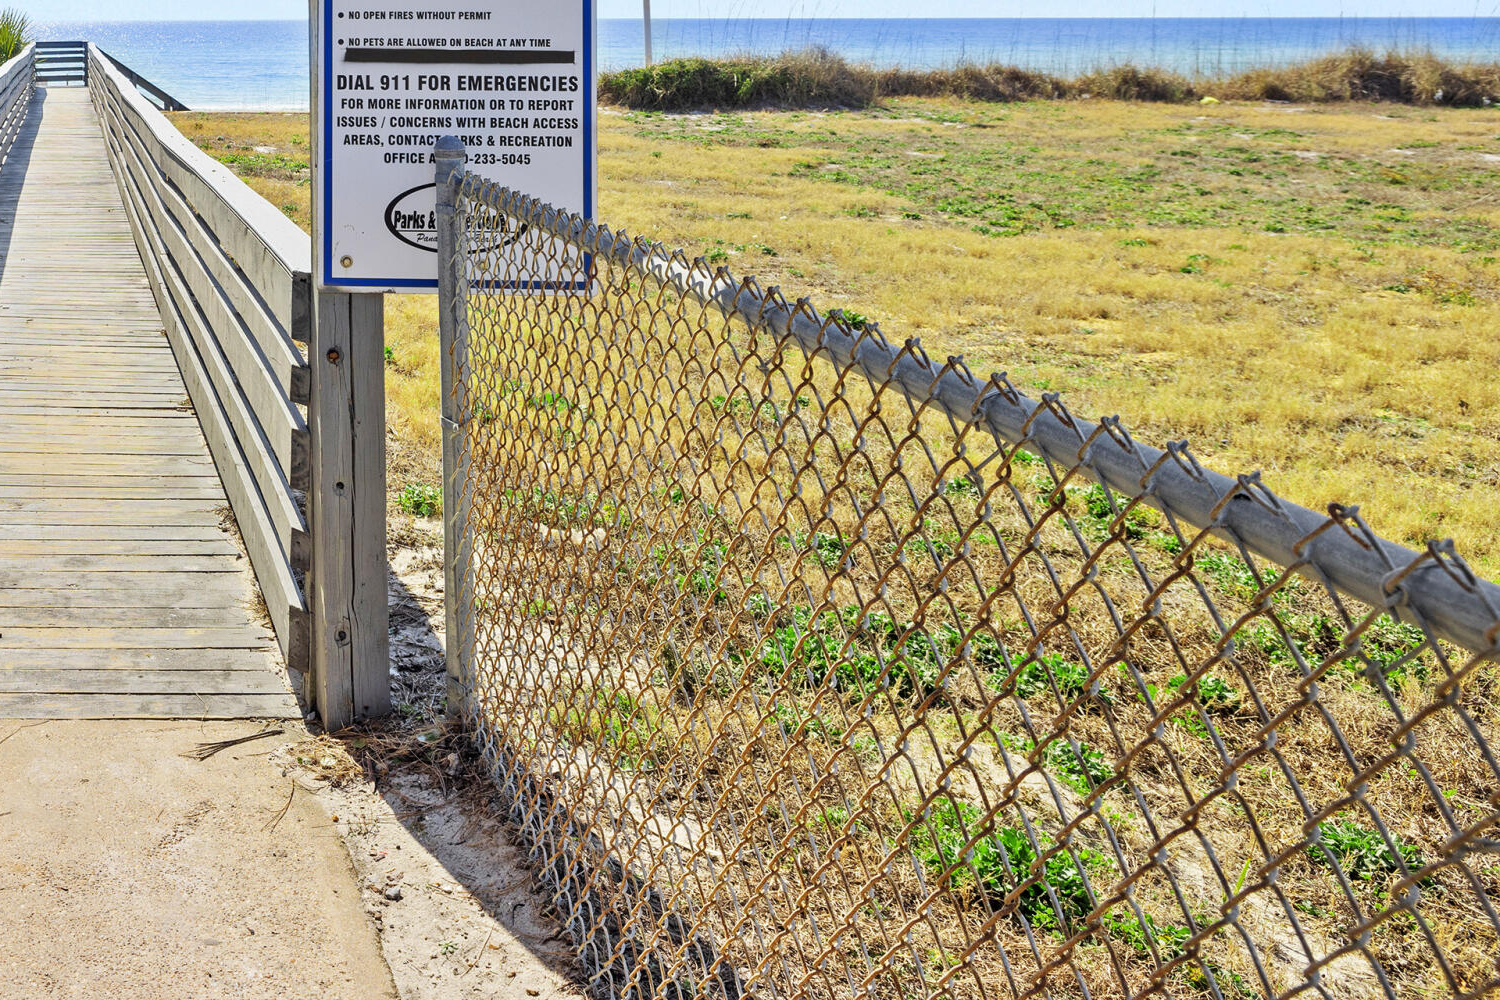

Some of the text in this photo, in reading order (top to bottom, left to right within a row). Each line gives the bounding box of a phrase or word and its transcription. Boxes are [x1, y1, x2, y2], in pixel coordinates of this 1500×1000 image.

[349, 11, 491, 20] NO OPEN FIRES WITHOUT PERMIT
[349, 38, 550, 47] NO PETS ARE ALLOWED ON BEACH AT ANY TIME
[337, 75, 578, 92] DIAL 911 FOR EMERGENCIES
[394, 210, 435, 230] Parks &
